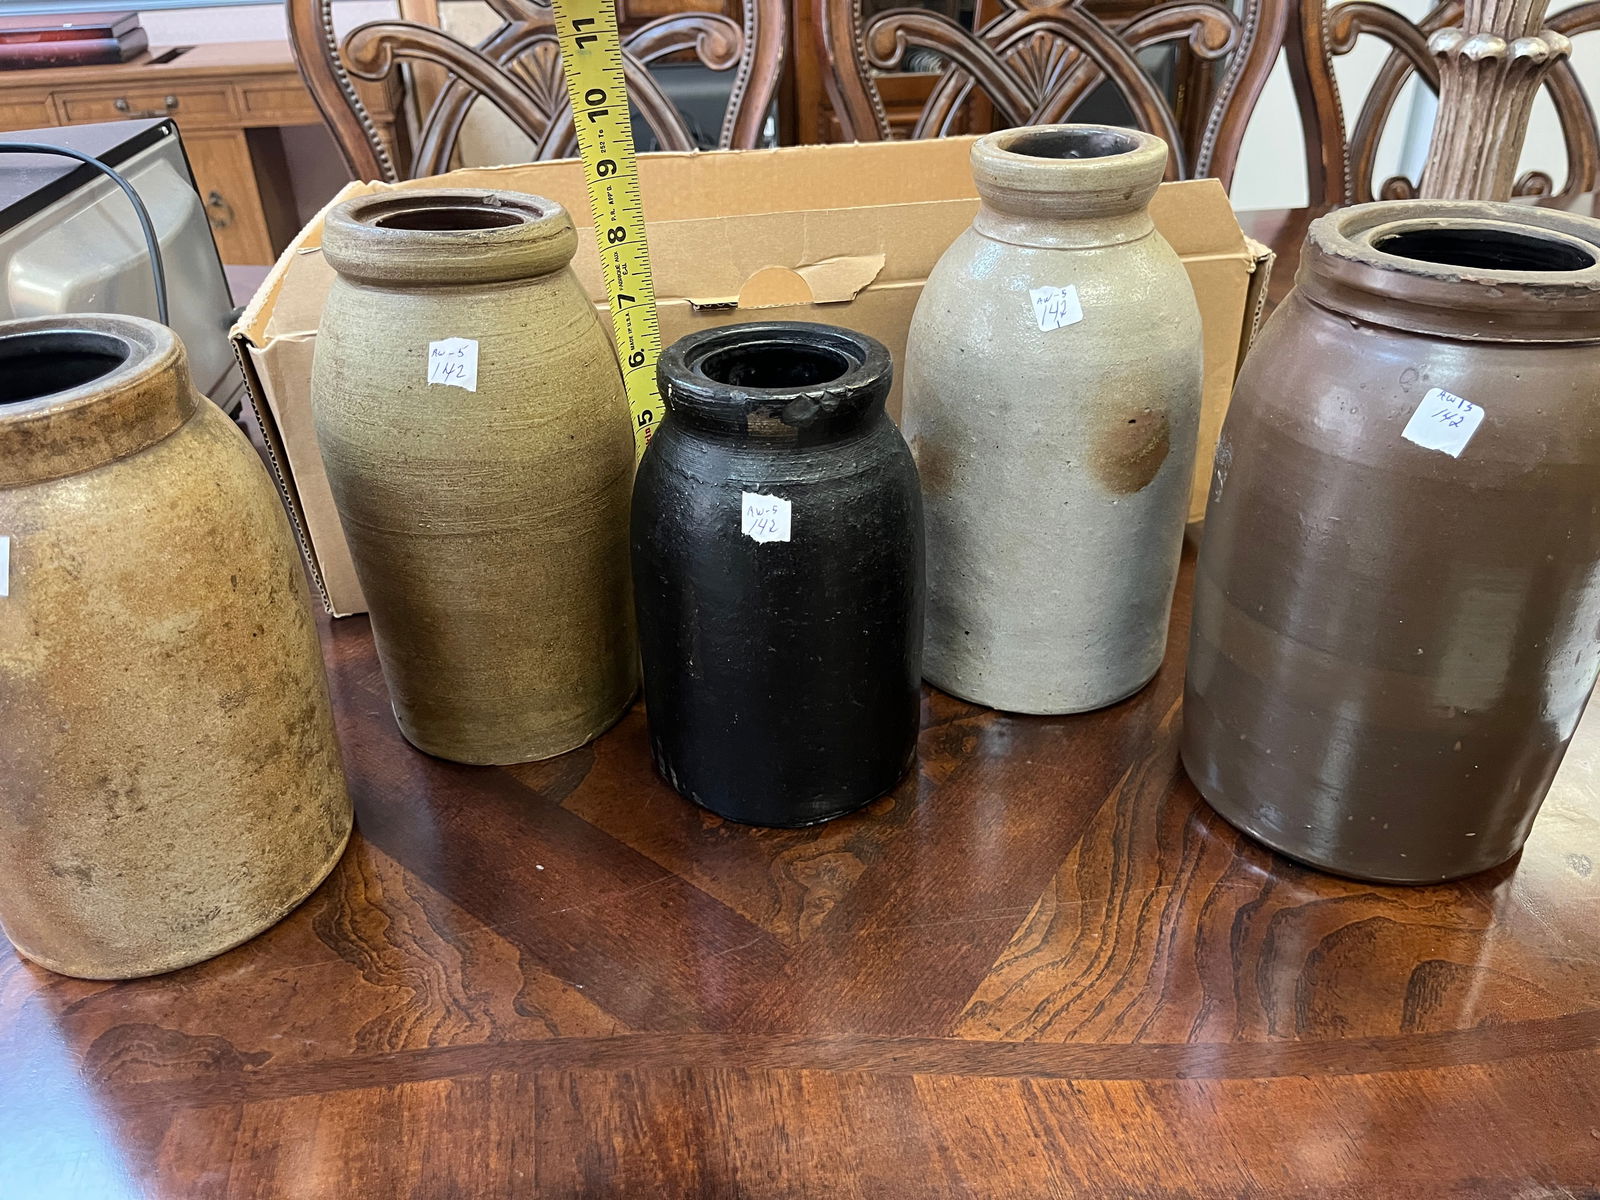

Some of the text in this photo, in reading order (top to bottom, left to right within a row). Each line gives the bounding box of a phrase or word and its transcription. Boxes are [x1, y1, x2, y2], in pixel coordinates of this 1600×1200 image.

[571, 17, 598, 50] 11
[584, 88, 609, 123] 10
[596, 159, 617, 177] 9
[607, 226, 627, 244] 8
[617, 294, 635, 309] 7
[1042, 299, 1067, 326] 142
[431, 362, 466, 383] 142
[637, 409, 653, 426] 5
[748, 519, 779, 535] 142
